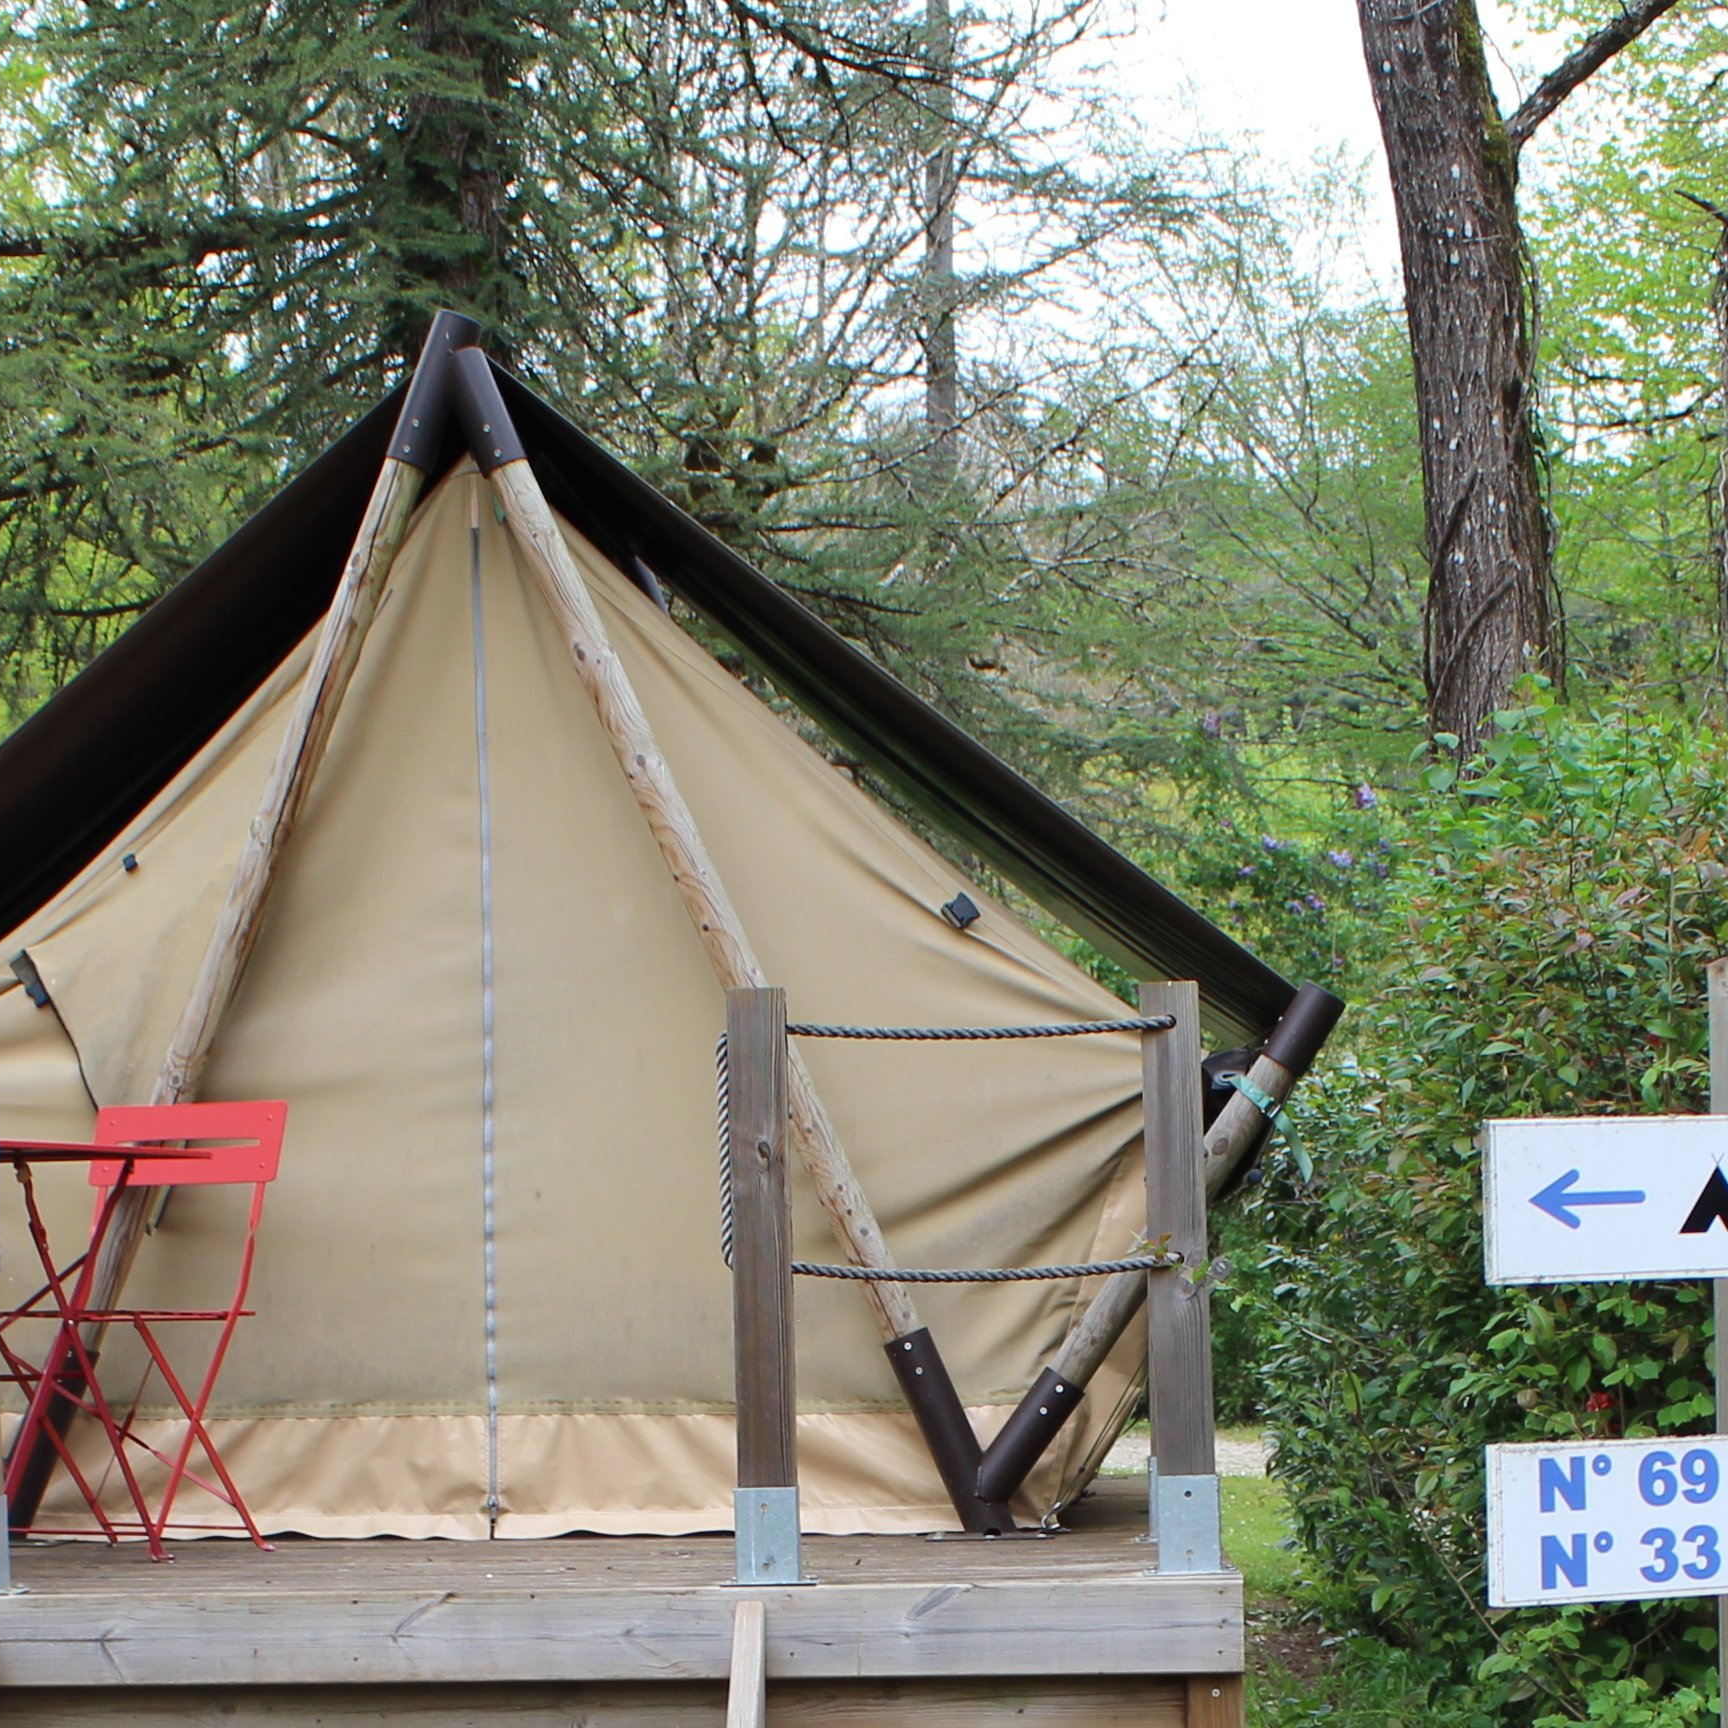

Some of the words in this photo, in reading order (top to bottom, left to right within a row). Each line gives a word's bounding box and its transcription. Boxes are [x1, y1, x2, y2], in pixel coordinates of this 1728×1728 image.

[1539, 1453, 1613, 1514] N°
[1638, 1447, 1721, 1507] 69
[1541, 1529, 1615, 1591] N°
[1640, 1523, 1722, 1583] 33
